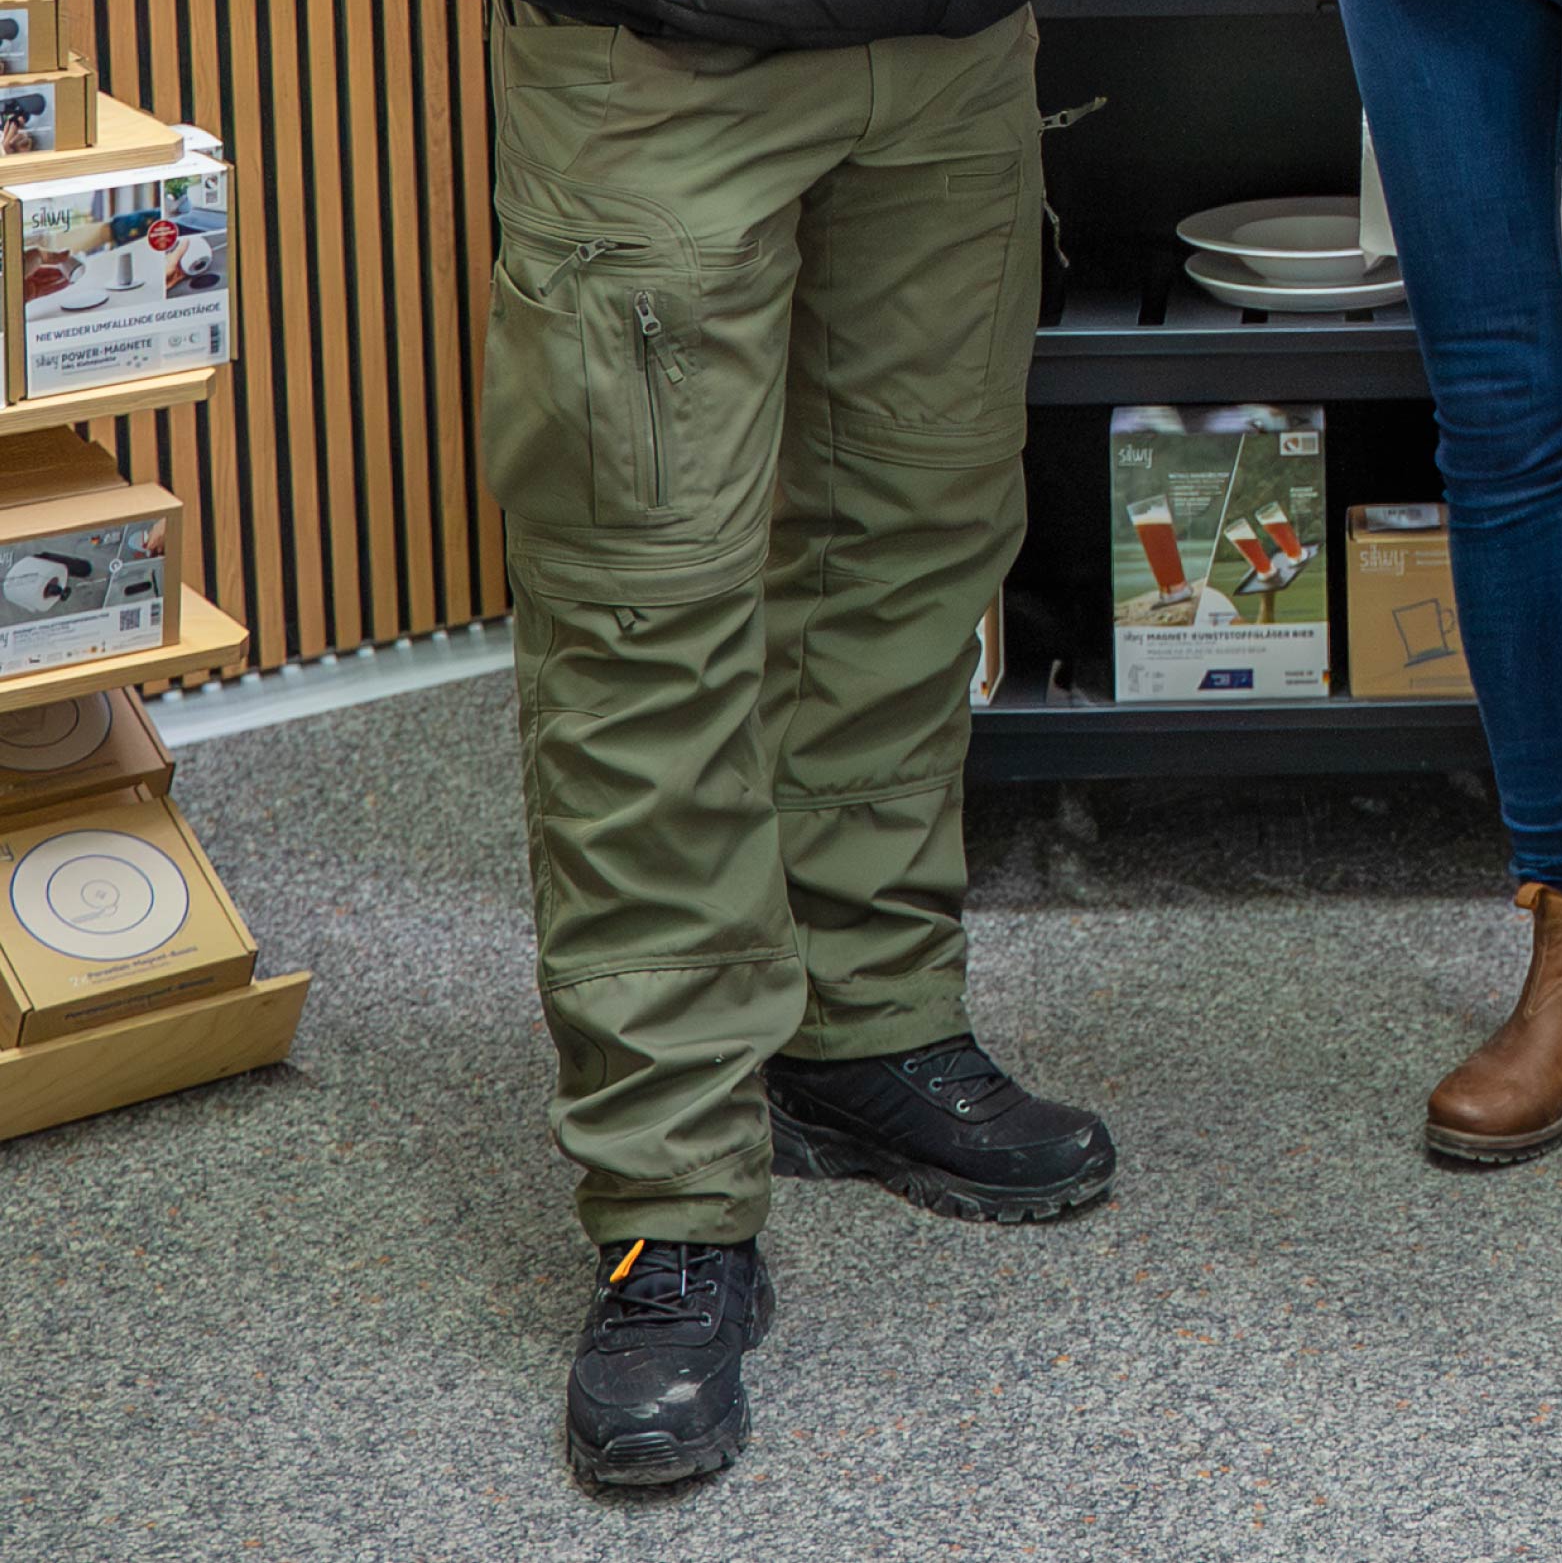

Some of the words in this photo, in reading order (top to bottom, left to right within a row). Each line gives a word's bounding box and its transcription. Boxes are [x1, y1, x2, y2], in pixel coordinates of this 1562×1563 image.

[31, 206, 71, 233] silwy
[36, 332, 53, 343] NIE
[54, 325, 91, 342] WIEDER
[91, 313, 154, 333] UMFALLENDE
[155, 302, 221, 322] GEGENSTÄNDE
[1117, 444, 1154, 469] silwy
[1360, 543, 1407, 577] silwy
